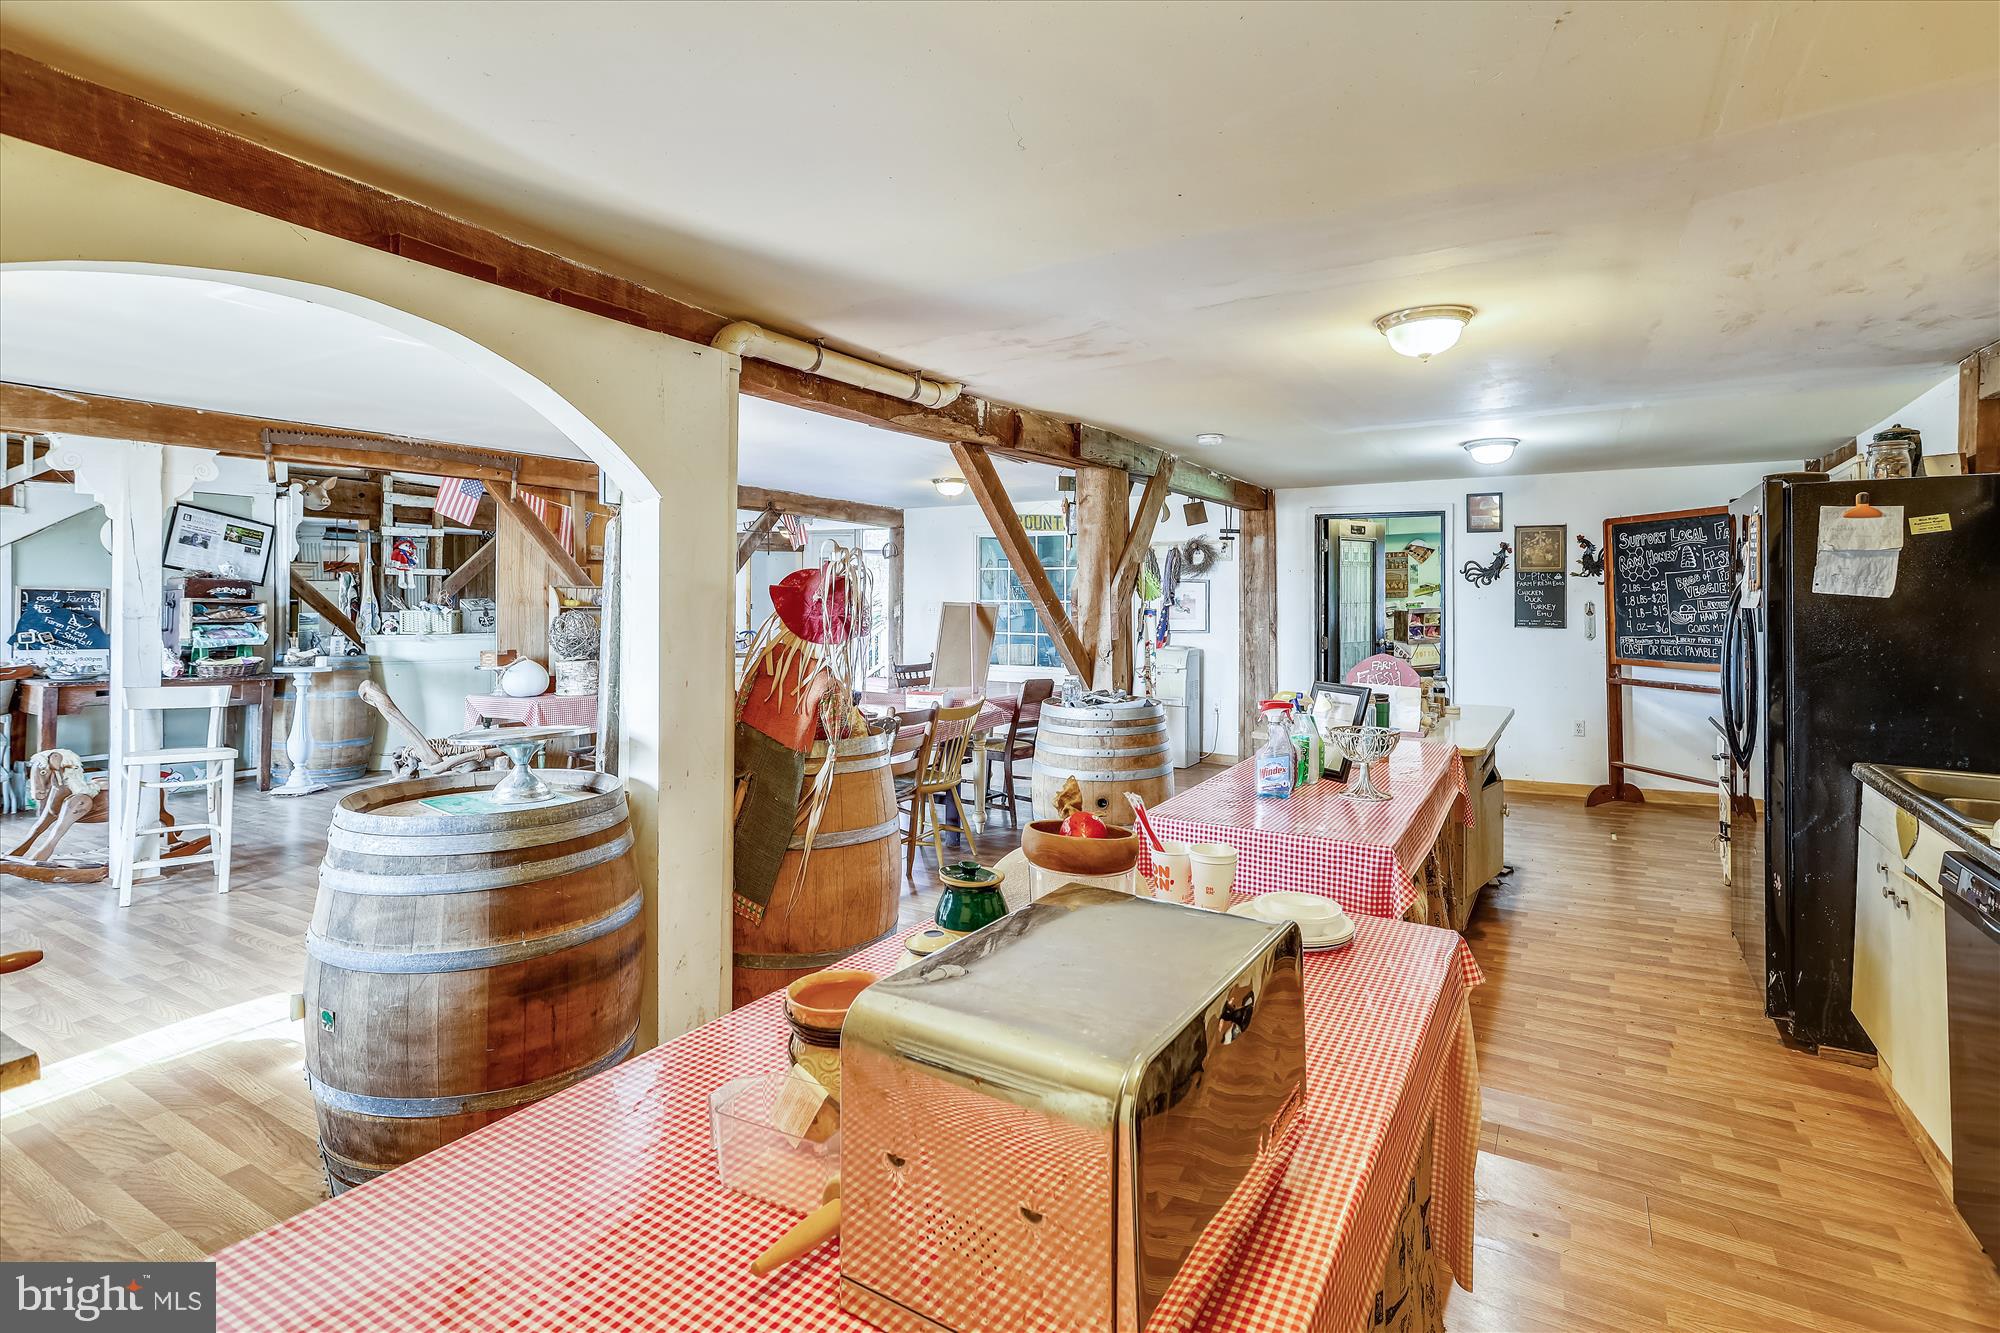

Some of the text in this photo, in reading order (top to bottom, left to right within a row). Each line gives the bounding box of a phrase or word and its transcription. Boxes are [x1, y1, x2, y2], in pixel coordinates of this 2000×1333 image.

[1019, 515, 1066, 530] OUNT
[1619, 532, 1666, 549] SUPPORT
[1670, 527, 1707, 542] LOCAL
[1619, 550, 1678, 572] RAW HONEY
[1675, 574, 1700, 590] BAGS
[1702, 570, 1711, 582] of
[1622, 584, 1628, 593] 2
[1628, 609, 1632, 618] 1
[1700, 612, 1719, 622] HAND
[44, 616, 88, 638] Farm Fresh
[1626, 620, 1632, 632] 4
[1688, 624, 1710, 633] GOATS
[1623, 644, 1718, 658] CASH OR CHECK PAYABLE
[1372, 660, 1398, 670] FARM
[1356, 670, 1402, 686] FRESH
[1261, 766, 1287, 778] Windex
